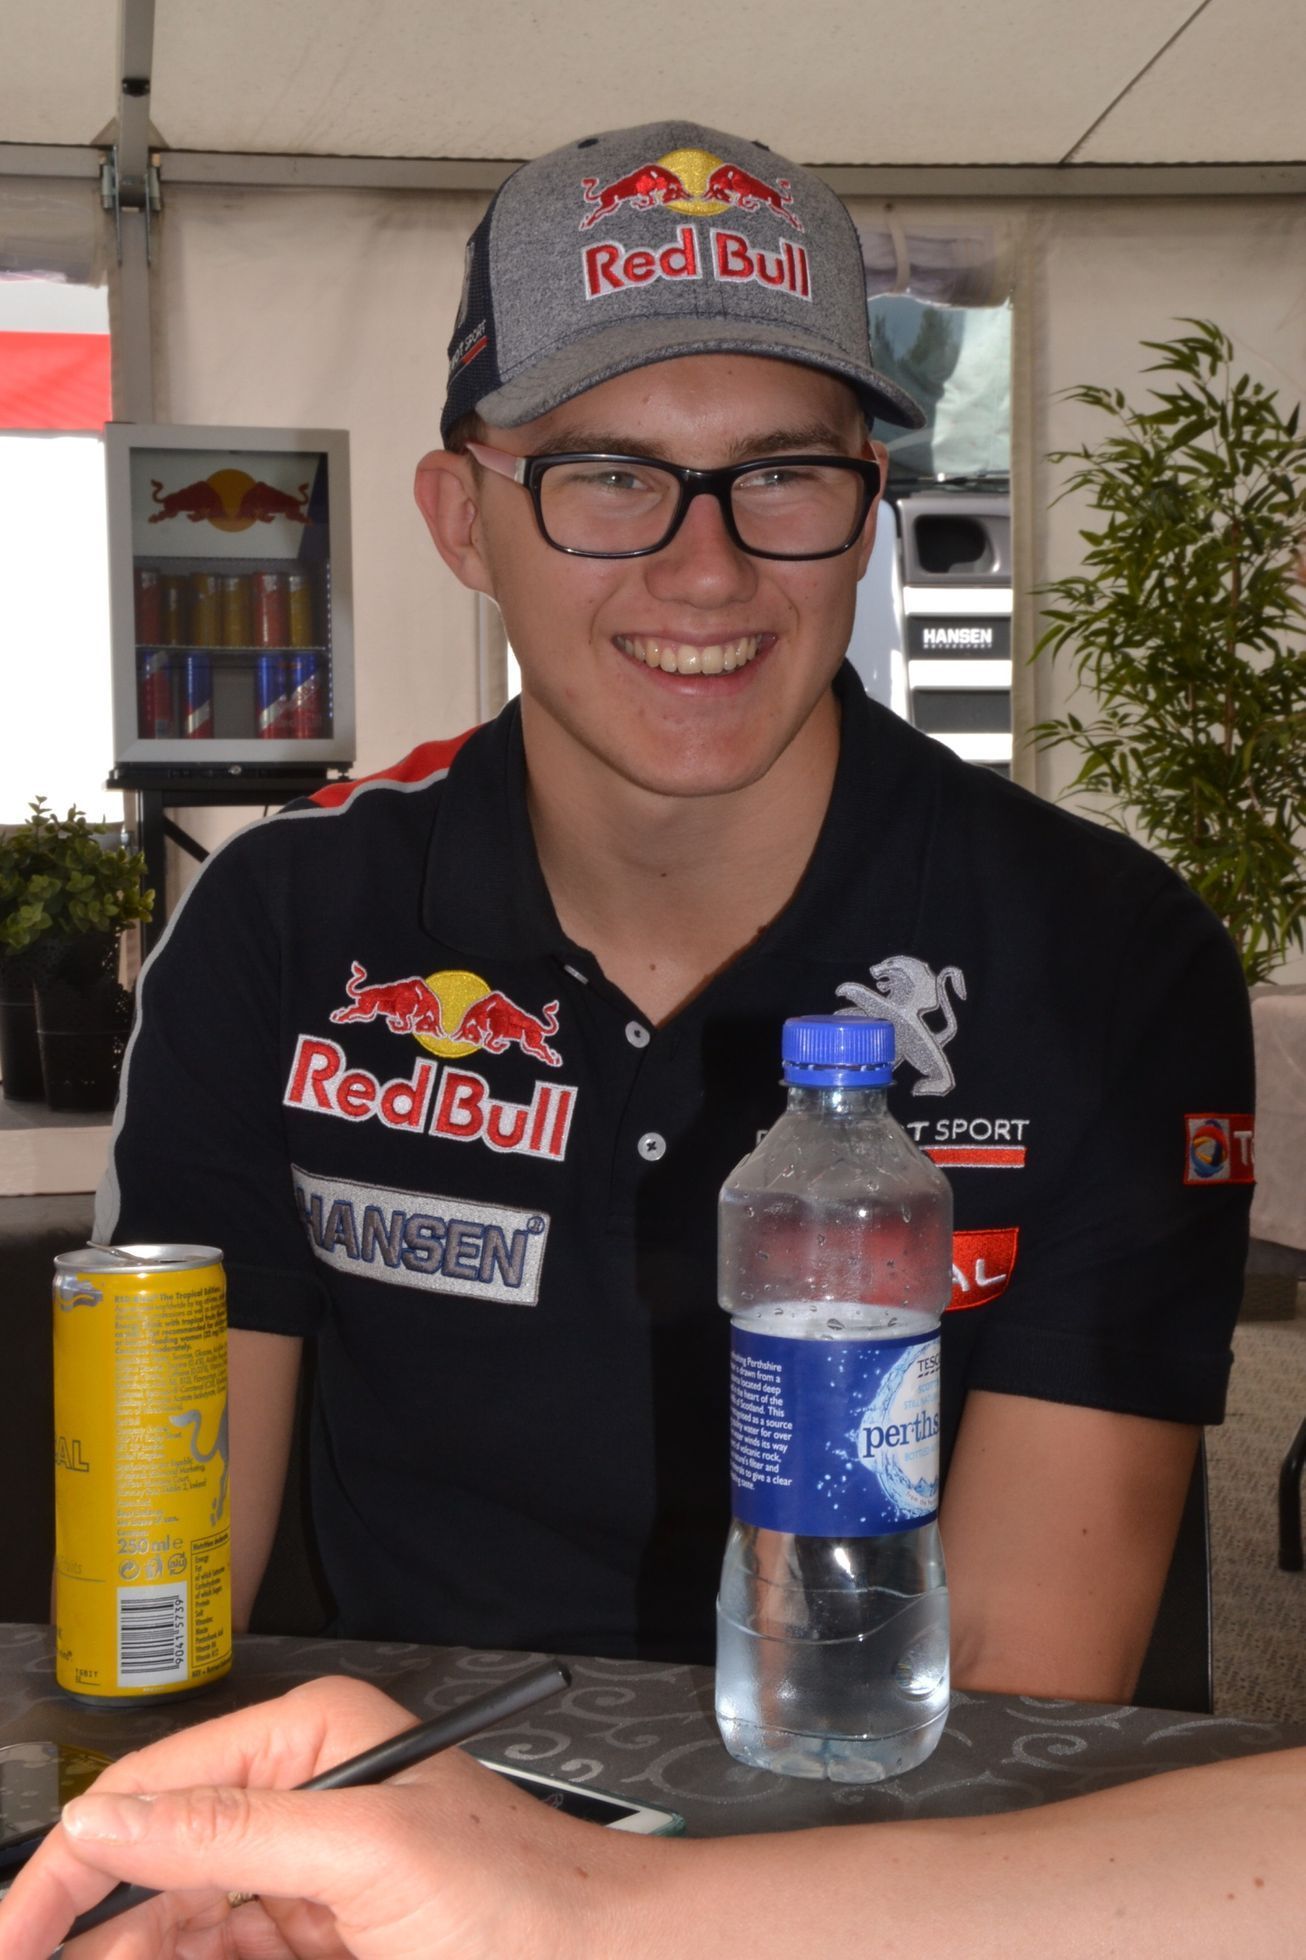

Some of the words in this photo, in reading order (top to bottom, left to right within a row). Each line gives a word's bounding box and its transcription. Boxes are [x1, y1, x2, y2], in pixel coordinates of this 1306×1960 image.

[582, 226, 702, 299] Red
[711, 228, 812, 300] Bull
[923, 628, 993, 644] HANSEN
[284, 1034, 437, 1133] Red
[430, 1066, 578, 1161] Bull
[934, 1118, 1030, 1141] SPORT
[747, 1357, 782, 1373] Perthshire
[741, 1377, 762, 1391] located
[762, 1382, 781, 1396] deep
[757, 1370, 774, 1382] from
[775, 1375, 781, 1384] a
[743, 1388, 760, 1402] heart
[760, 1394, 768, 1405] of
[769, 1396, 784, 1406] the
[740, 1398, 766, 1414] Scotland.
[768, 1405, 785, 1417] This
[752, 1414, 760, 1424] as
[766, 1418, 793, 1430] source
[743, 1423, 760, 1435] water
[760, 1426, 772, 1438] for
[773, 1431, 792, 1441] over
[740, 1443, 761, 1458] volcanic
[744, 1434, 760, 1447] winds
[761, 1438, 770, 1449] its
[771, 1443, 788, 1454] way
[749, 1455, 765, 1470] filter
[765, 1462, 779, 1474] and
[745, 1468, 752, 1478] to
[752, 1471, 765, 1483] give
[772, 1474, 793, 1487] clear
[118, 1538, 150, 1554] 250
[151, 1534, 170, 1551] ml
